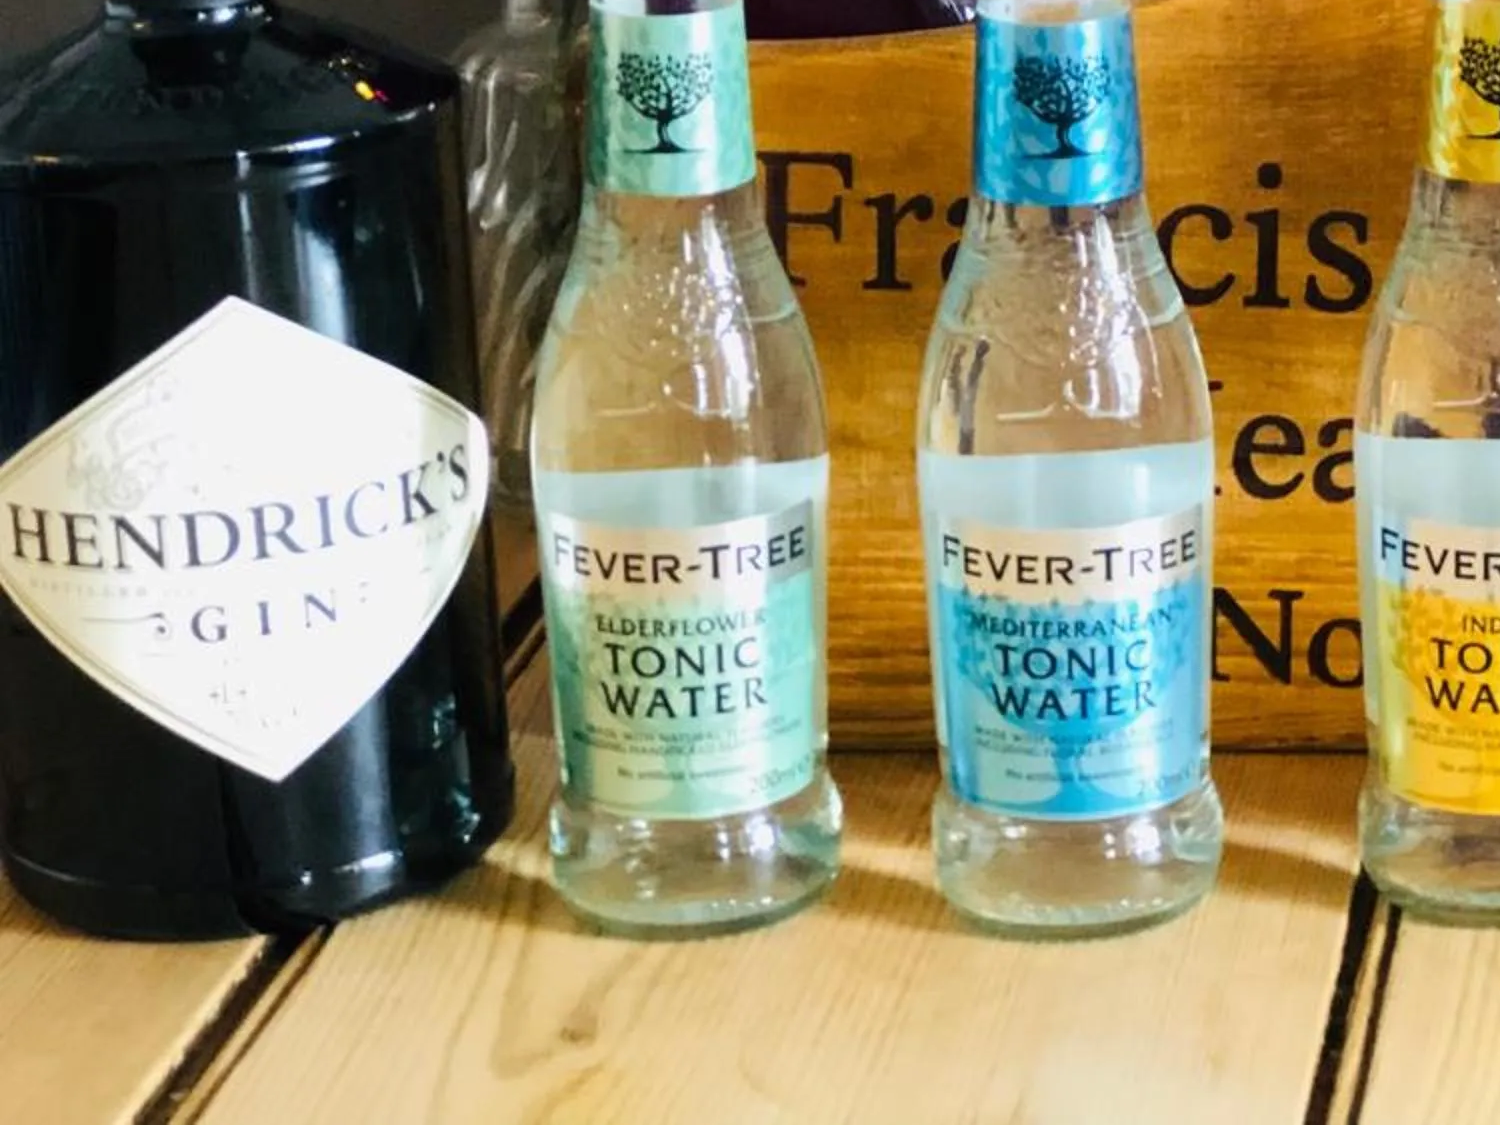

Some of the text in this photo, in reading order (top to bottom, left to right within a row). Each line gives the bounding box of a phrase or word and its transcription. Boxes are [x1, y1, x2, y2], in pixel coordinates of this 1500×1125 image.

[7, 443, 470, 572] HENDRICK'S
[553, 526, 806, 584] FEVER-TREE
[943, 529, 1197, 585] FEVER-TREE
[190, 588, 338, 643] GIN
[596, 609, 767, 639] ELDERFLOWER
[968, 608, 1174, 640] MEDITERRANEAN
[603, 637, 760, 678] TONIC
[994, 640, 1149, 681] TONIC
[600, 677, 768, 719] WATER
[991, 680, 1157, 721] WATER
